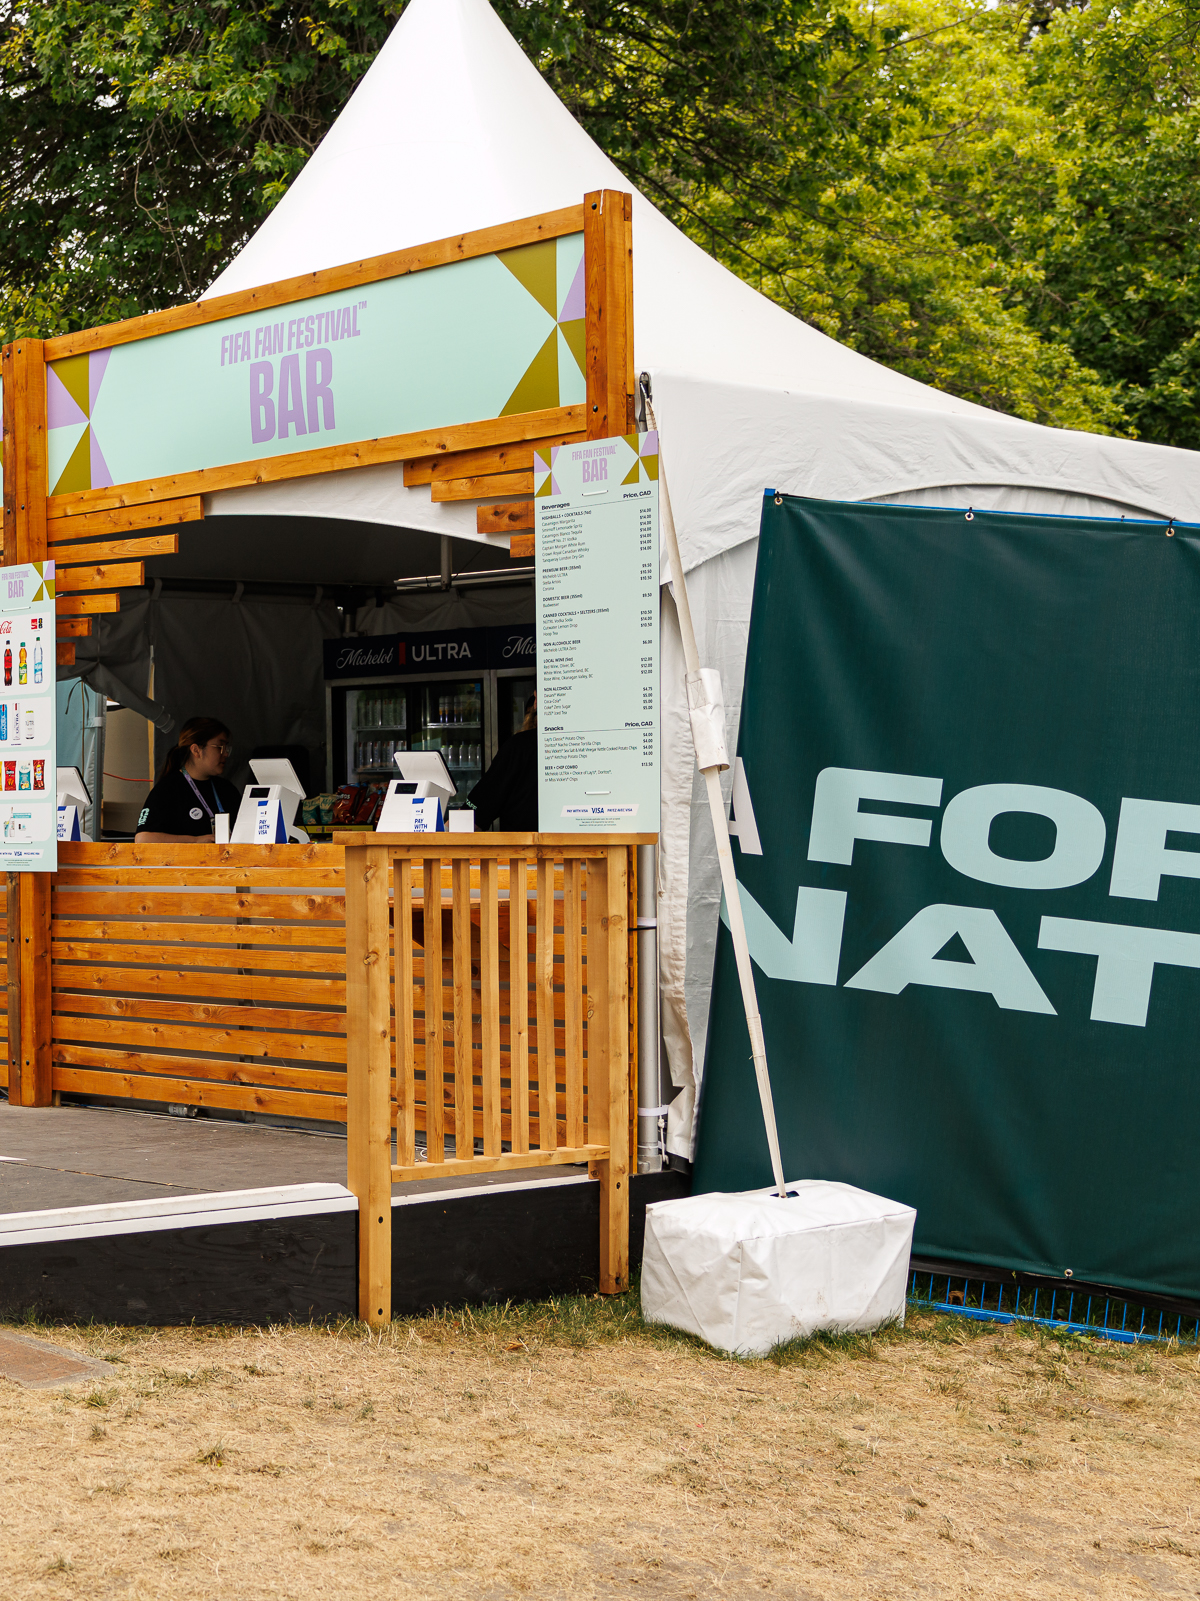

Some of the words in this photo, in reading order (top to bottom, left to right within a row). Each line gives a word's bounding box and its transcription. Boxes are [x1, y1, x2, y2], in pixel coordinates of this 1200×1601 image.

[221, 330, 251, 367] FIFA
[254, 322, 284, 358] FAN
[250, 348, 336, 444] BAR
[572, 450, 582, 461] FIFA
[583, 449, 592, 459] FAN
[582, 458, 608, 483] BAR
[541, 502, 570, 511] Beverages
[8, 580, 24, 598] BAR
[336, 648, 394, 669] Michelob
[412, 642, 471, 662] ULTRA
